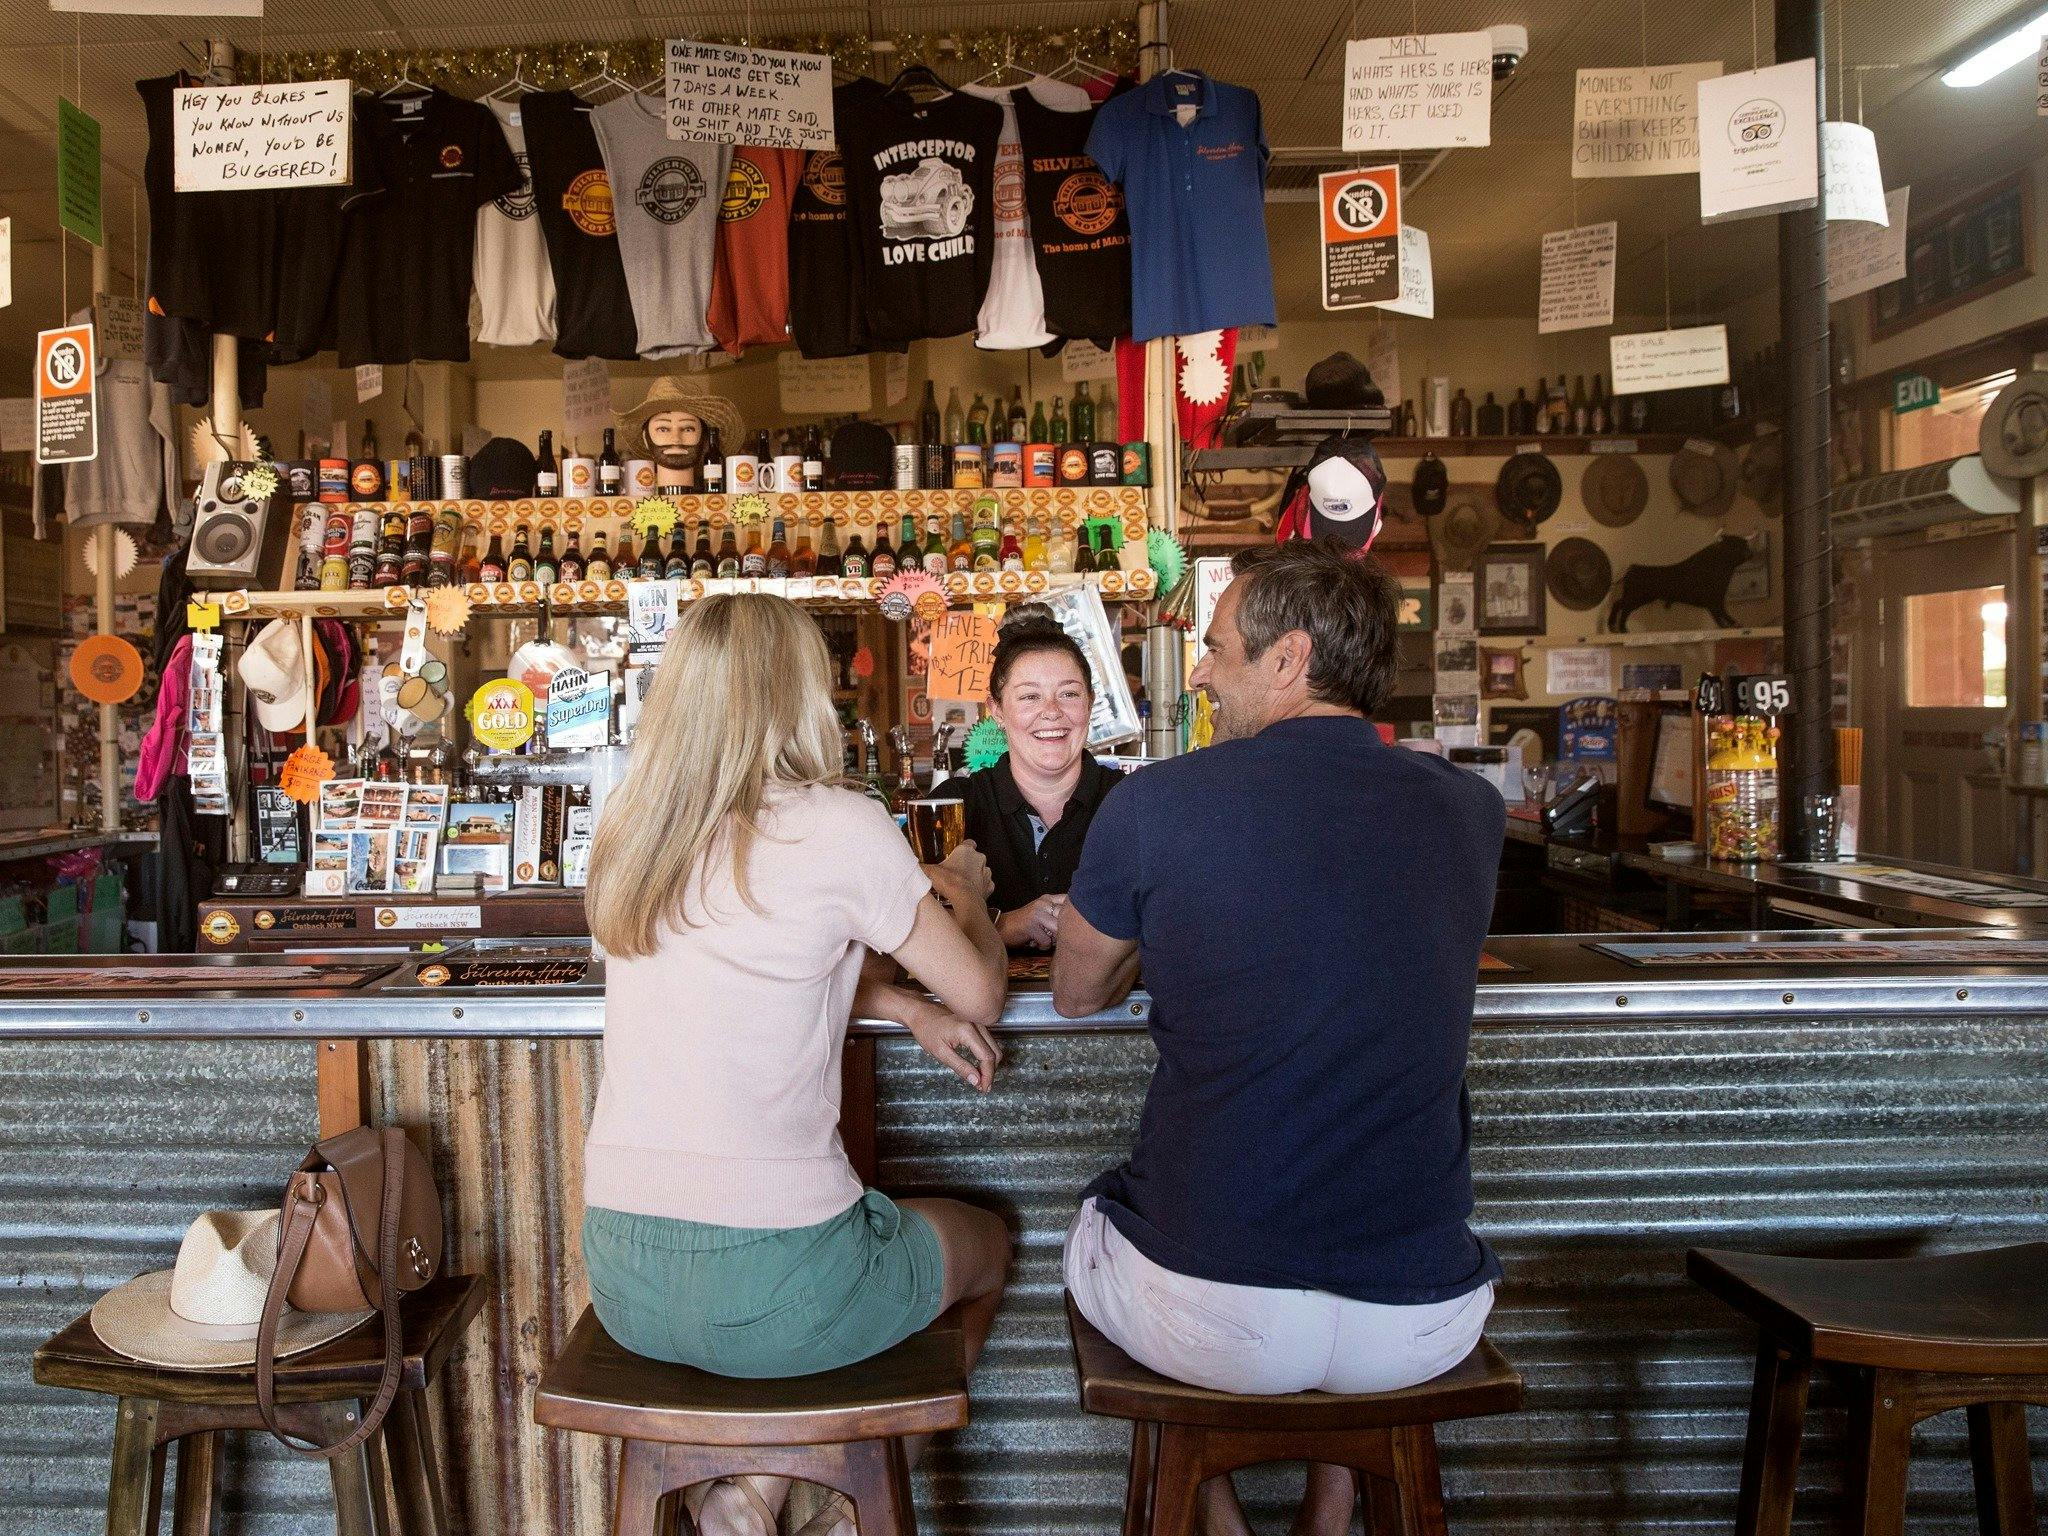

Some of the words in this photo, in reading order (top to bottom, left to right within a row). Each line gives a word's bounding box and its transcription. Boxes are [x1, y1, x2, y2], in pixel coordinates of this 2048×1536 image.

[1389, 37, 1427, 56] MEN
[671, 44, 693, 59] ONE
[695, 45, 720, 61] MATE
[751, 53, 767, 66] DO
[768, 56, 786, 70] YOU
[791, 58, 822, 71] KNOW
[670, 60, 700, 74] THAT
[706, 65, 741, 79] LIONS
[747, 69, 771, 84] GET
[774, 72, 801, 87] SEX
[1352, 65, 1393, 80] WHATS
[1400, 62, 1437, 78] HERS
[1443, 63, 1454, 77] IS
[1460, 59, 1491, 76] HERS
[672, 78, 681, 94] 7
[683, 80, 716, 96] DAYS
[720, 84, 731, 96] A
[1650, 71, 1682, 90] NOT
[182, 94, 209, 111] HEY
[216, 94, 242, 112] YOU
[252, 90, 306, 106] BLOKES
[1350, 87, 1373, 101] AND
[1379, 83, 1419, 99] WHATS
[1427, 83, 1462, 98] YOURS
[1467, 82, 1483, 96] IS
[668, 97, 695, 112] THE
[702, 102, 741, 119] OTHER
[747, 107, 780, 122] MATE
[1389, 104, 1421, 120] GET
[1427, 104, 1463, 119] USED
[1584, 94, 1688, 116] EVERYTHING
[191, 117, 212, 136] YOU
[220, 118, 253, 131] KNOW
[261, 110, 323, 128] WITHOUT
[327, 110, 344, 123] US
[672, 115, 690, 127] OH
[698, 117, 730, 132] SHIT
[736, 122, 761, 136] AND
[769, 125, 793, 139] I'VE
[799, 128, 832, 141] JUST
[1346, 125, 1362, 140] TO
[1578, 120, 1612, 140] BUT
[1619, 118, 1637, 138] IT
[1642, 117, 1686, 137] KEEPS
[192, 138, 249, 158] WOMEN,
[265, 136, 306, 155] YOU'D
[316, 133, 335, 148] BE
[680, 129, 736, 144] JOINED
[873, 139, 976, 171] INTERCEPTOR
[1576, 141, 1651, 163] CHILDREN
[1658, 140, 1672, 160] IN
[645, 161, 698, 185] SILVERTON
[654, 204, 691, 220] HOTEL
[1074, 209, 1113, 230] HOTEL
[1346, 197, 1374, 224] 18
[882, 243, 925, 266] LOVE
[928, 235, 976, 262] CHILD
[1043, 244, 1061, 254] The
[1063, 242, 1089, 253] home
[1091, 240, 1101, 249] of
[1897, 376, 1933, 408] EXIT
[847, 566, 860, 574] VB
[639, 589, 668, 606] WIN
[937, 615, 983, 639] HAVE
[956, 640, 996, 665] TRIE
[551, 673, 588, 694] HAHN
[952, 667, 991, 695] TE
[487, 698, 519, 710] XXXX
[1754, 680, 1790, 710] 95
[477, 712, 528, 731] GOLD
[280, 908, 326, 924] Silverton
[326, 906, 356, 923] Hotel
[403, 907, 448, 922] Silverton
[450, 907, 479, 921] Hotel
[292, 923, 324, 931] Outback
[460, 963, 537, 980] Silverton
[537, 962, 588, 979] Hotel
